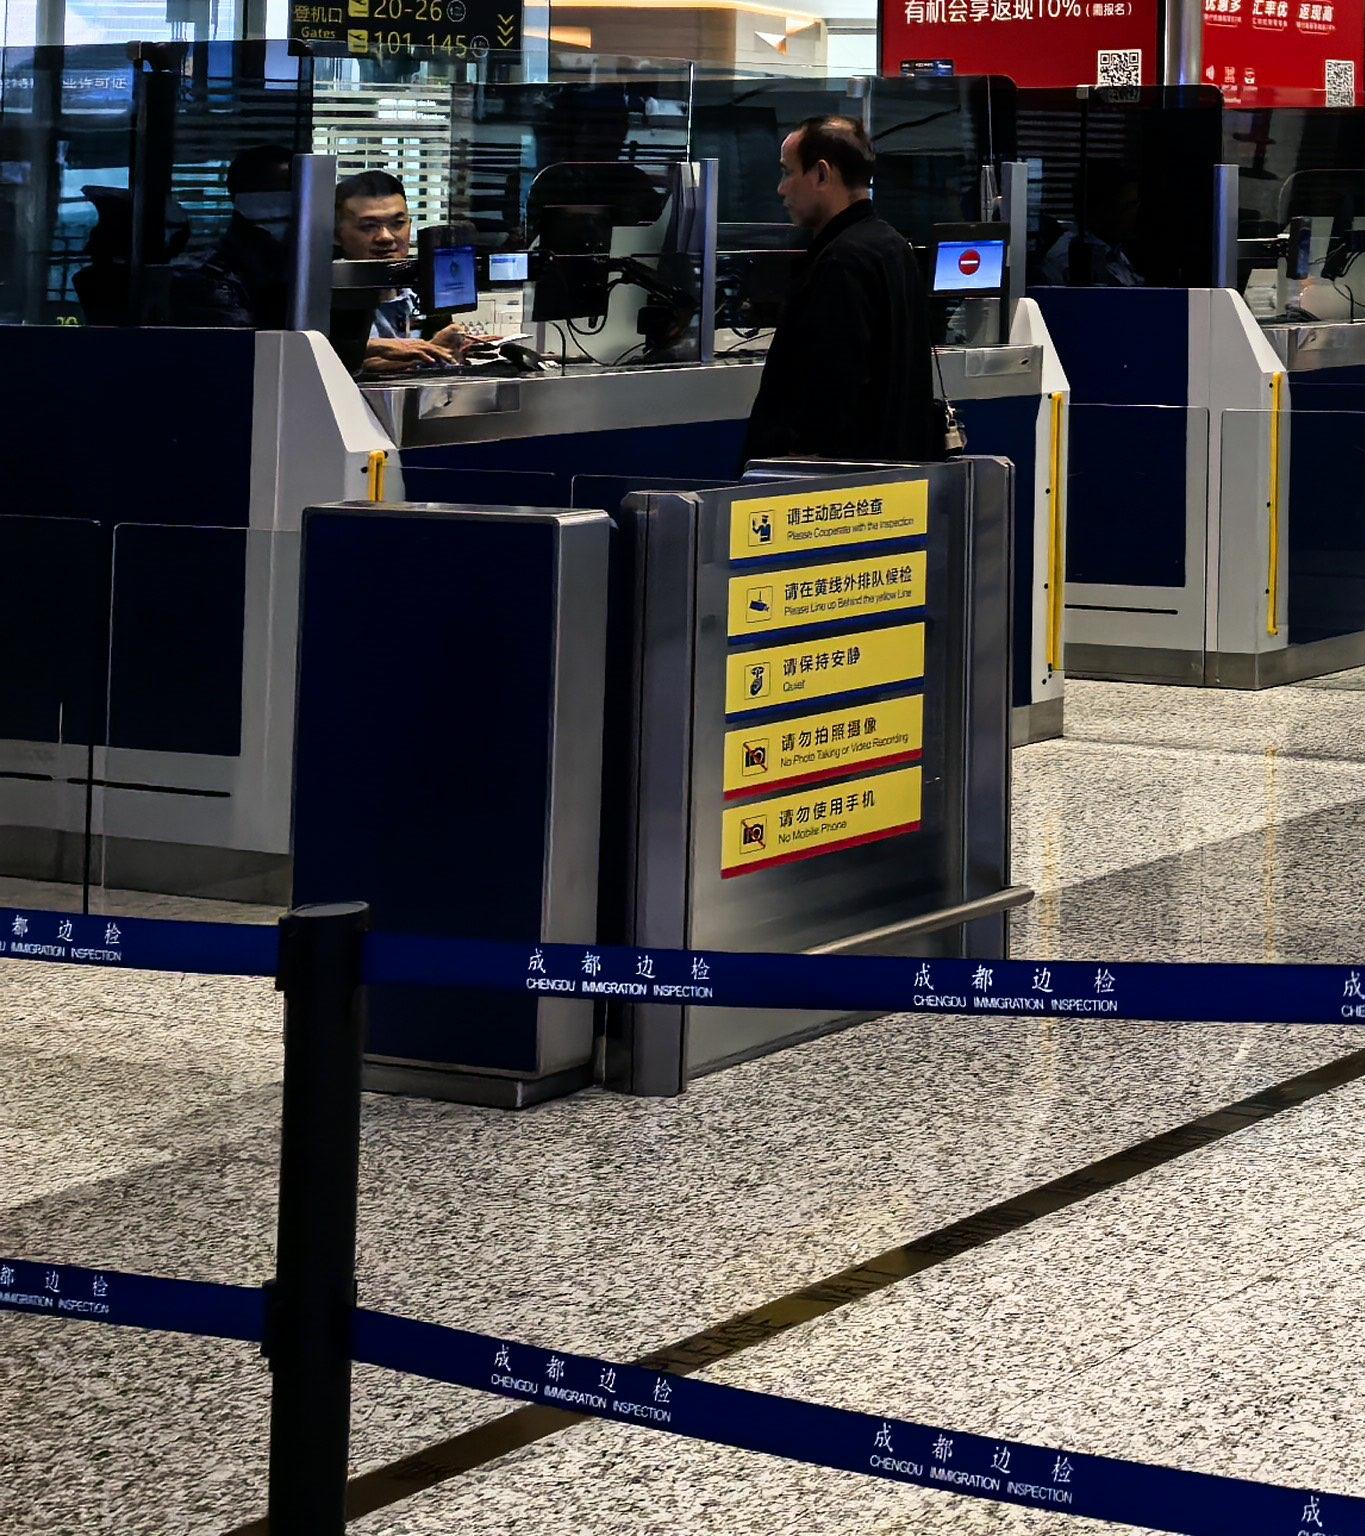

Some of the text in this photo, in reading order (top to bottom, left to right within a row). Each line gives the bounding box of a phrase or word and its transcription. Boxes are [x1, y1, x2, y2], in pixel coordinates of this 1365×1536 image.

[294, 6, 342, 24] 登机口
[301, 26, 336, 39] Gates
[787, 498, 883, 525] 请主动配合检查
[787, 529, 812, 541] Please
[785, 565, 912, 601] 请在黄线外排队候检
[784, 605, 810, 616] Please
[810, 602, 826, 613] Line
[783, 646, 860, 676] 请保持安静
[782, 717, 876, 751] 请勿拍照摄像
[780, 733, 909, 768] No Photo Taking or Video Recording
[779, 790, 875, 827] 请勿使用手机
[778, 821, 847, 844] No Mobile Phone
[71, 947, 122, 961] INSPECTION
[526, 978, 713, 998] CHENGDU IMMIGRATION INSPECTION
[913, 995, 1118, 1012] CHENGDU IMMIGRATION INSPECTION
[490, 1374, 672, 1423] CHENGDU IMMIGRATION INSPECTION
[870, 1455, 1073, 1504] CHENGDU IMMIGRATION INSPECTION
